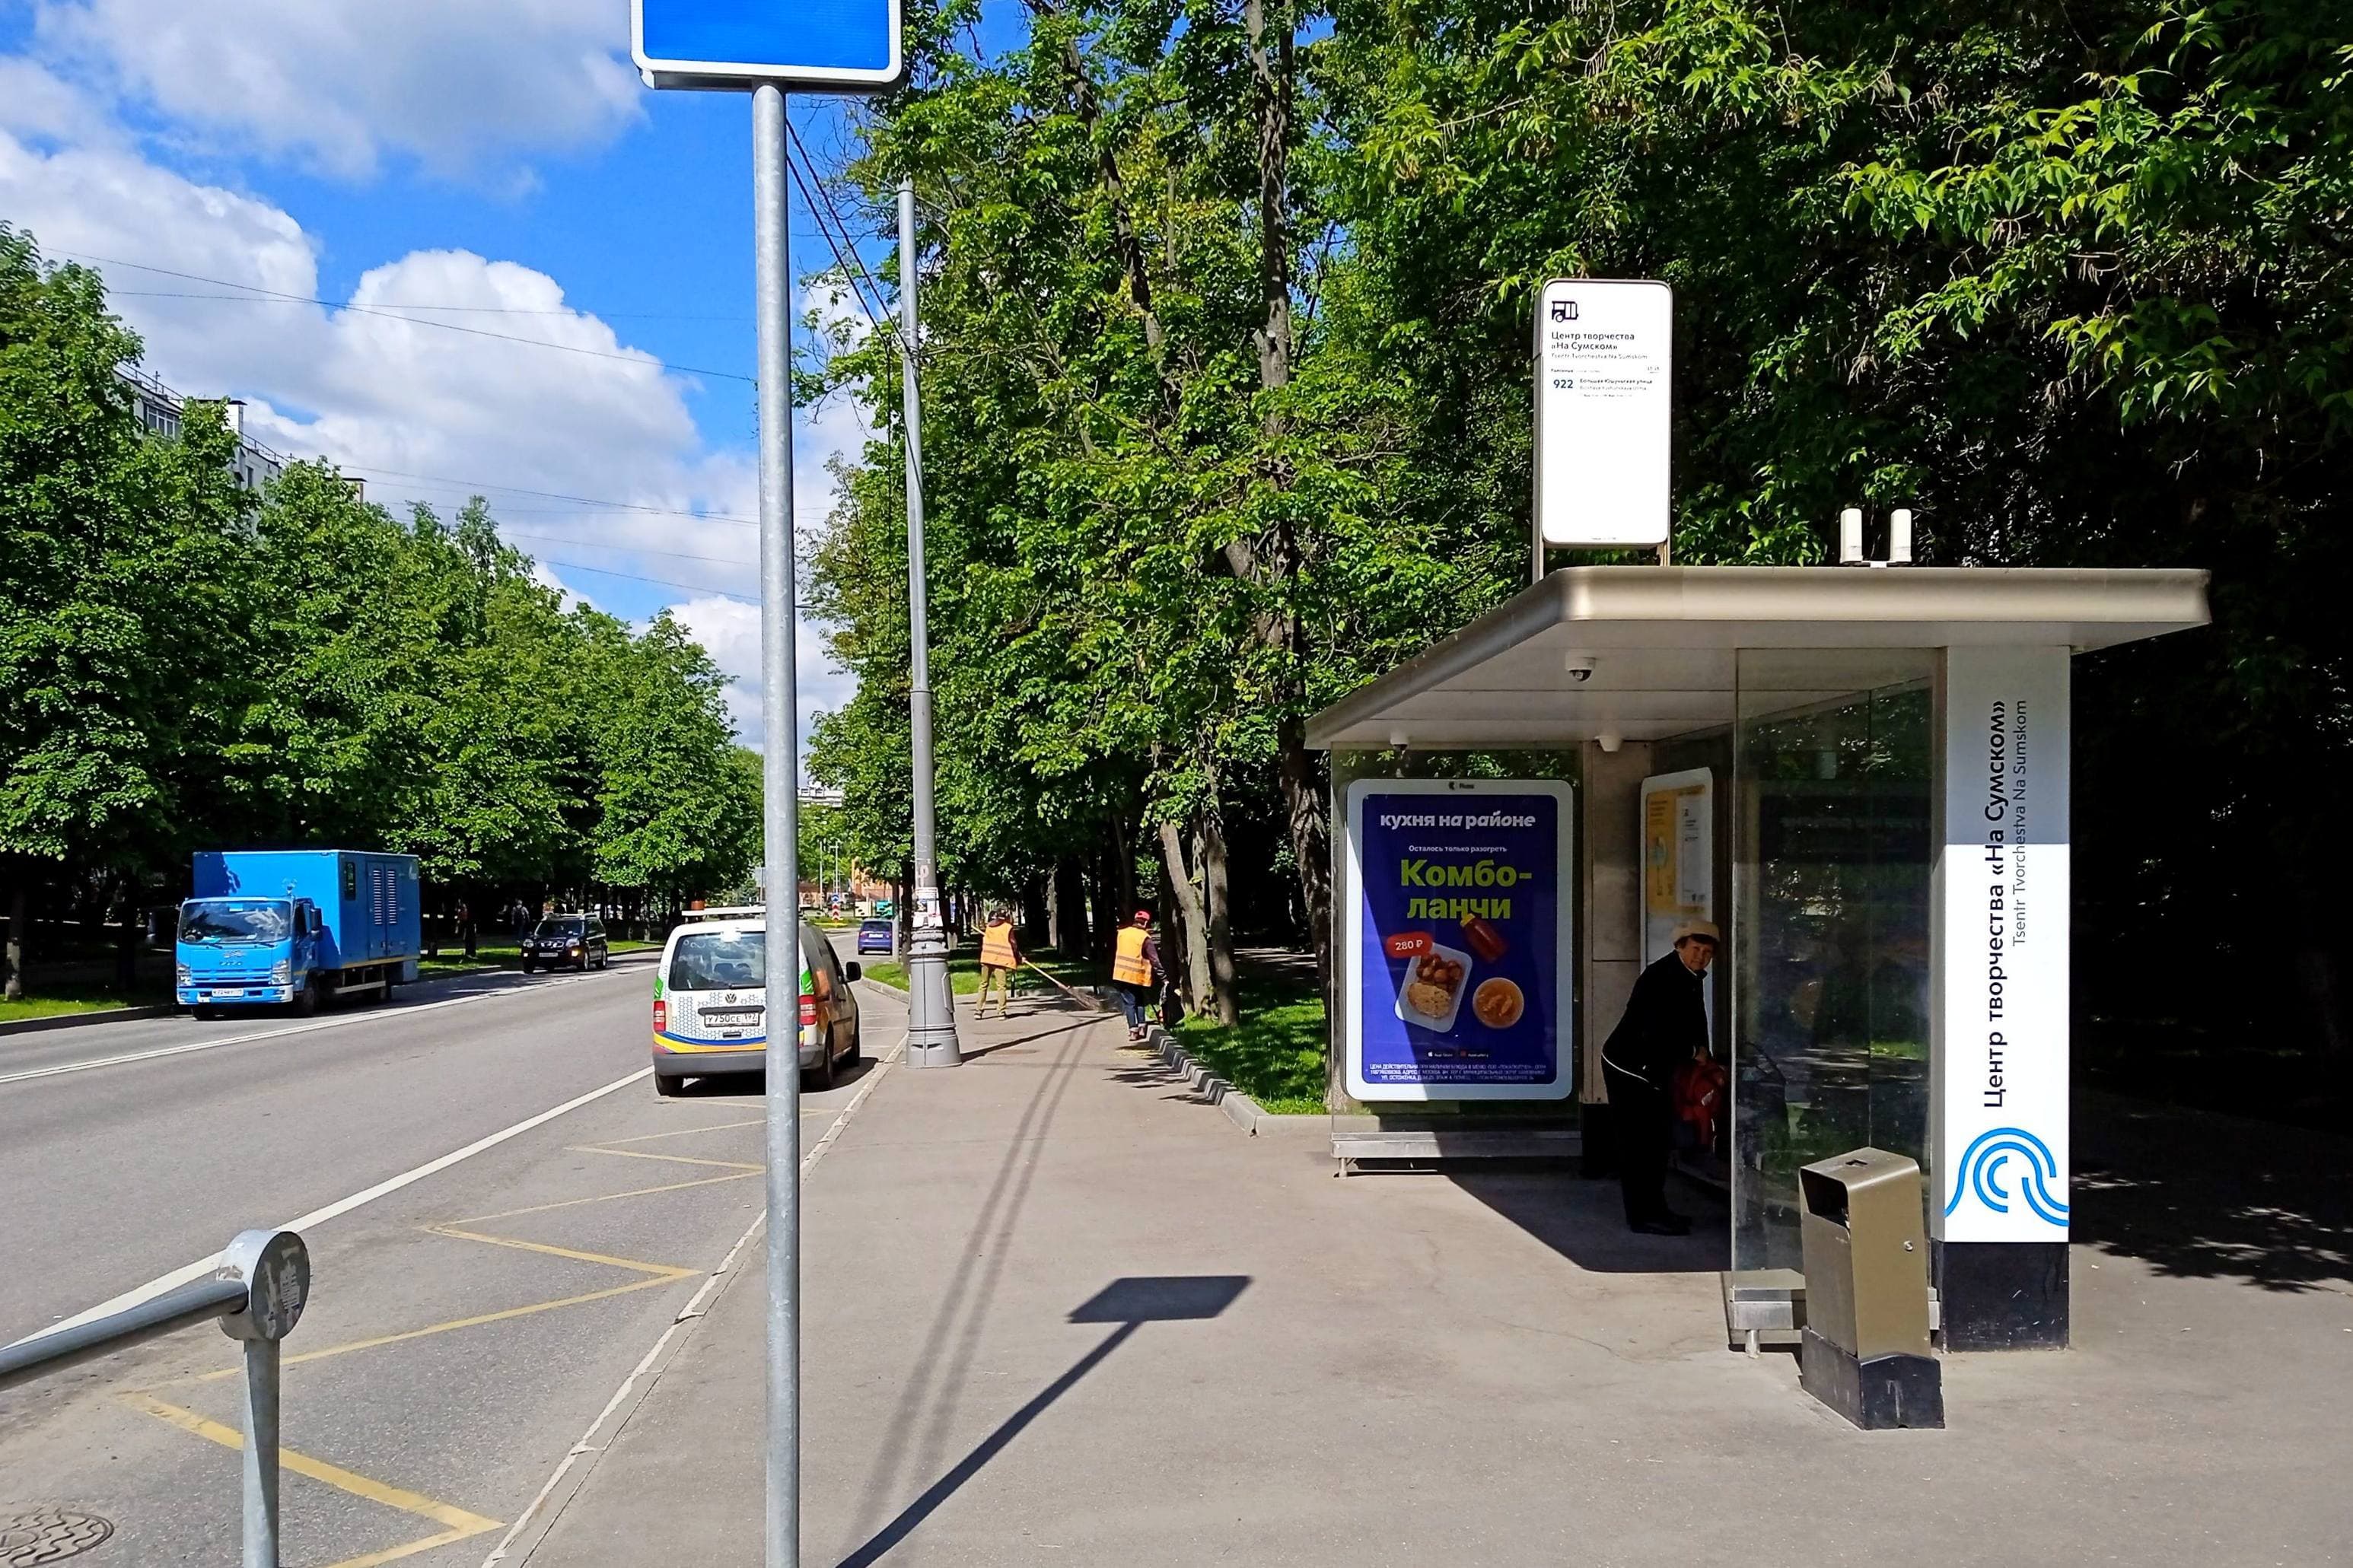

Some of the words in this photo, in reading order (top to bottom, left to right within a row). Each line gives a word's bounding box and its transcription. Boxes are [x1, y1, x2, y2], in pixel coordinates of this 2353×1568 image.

[1551, 332, 1581, 340] Центр
[1571, 342, 1618, 351] Сумском»
[1553, 379, 1573, 389] 922
[2013, 700, 2027, 774] Sumskom
[1985, 701, 2009, 822] Сумском»
[2013, 779, 2026, 800] Na
[1380, 815, 1435, 830] кухня
[1439, 816, 1463, 827] на
[1465, 810, 1536, 829] районе
[1985, 830, 2004, 875] «На
[2013, 806, 2026, 895] Tvorchestva
[1400, 859, 1533, 887] Комбо-
[1406, 898, 1511, 920] ланчи
[2013, 899, 2026, 946] Tsentr
[1395, 940, 1414, 950] 280
[1989, 885, 2008, 1022] творчества
[1984, 1032, 2008, 1107] Центр
